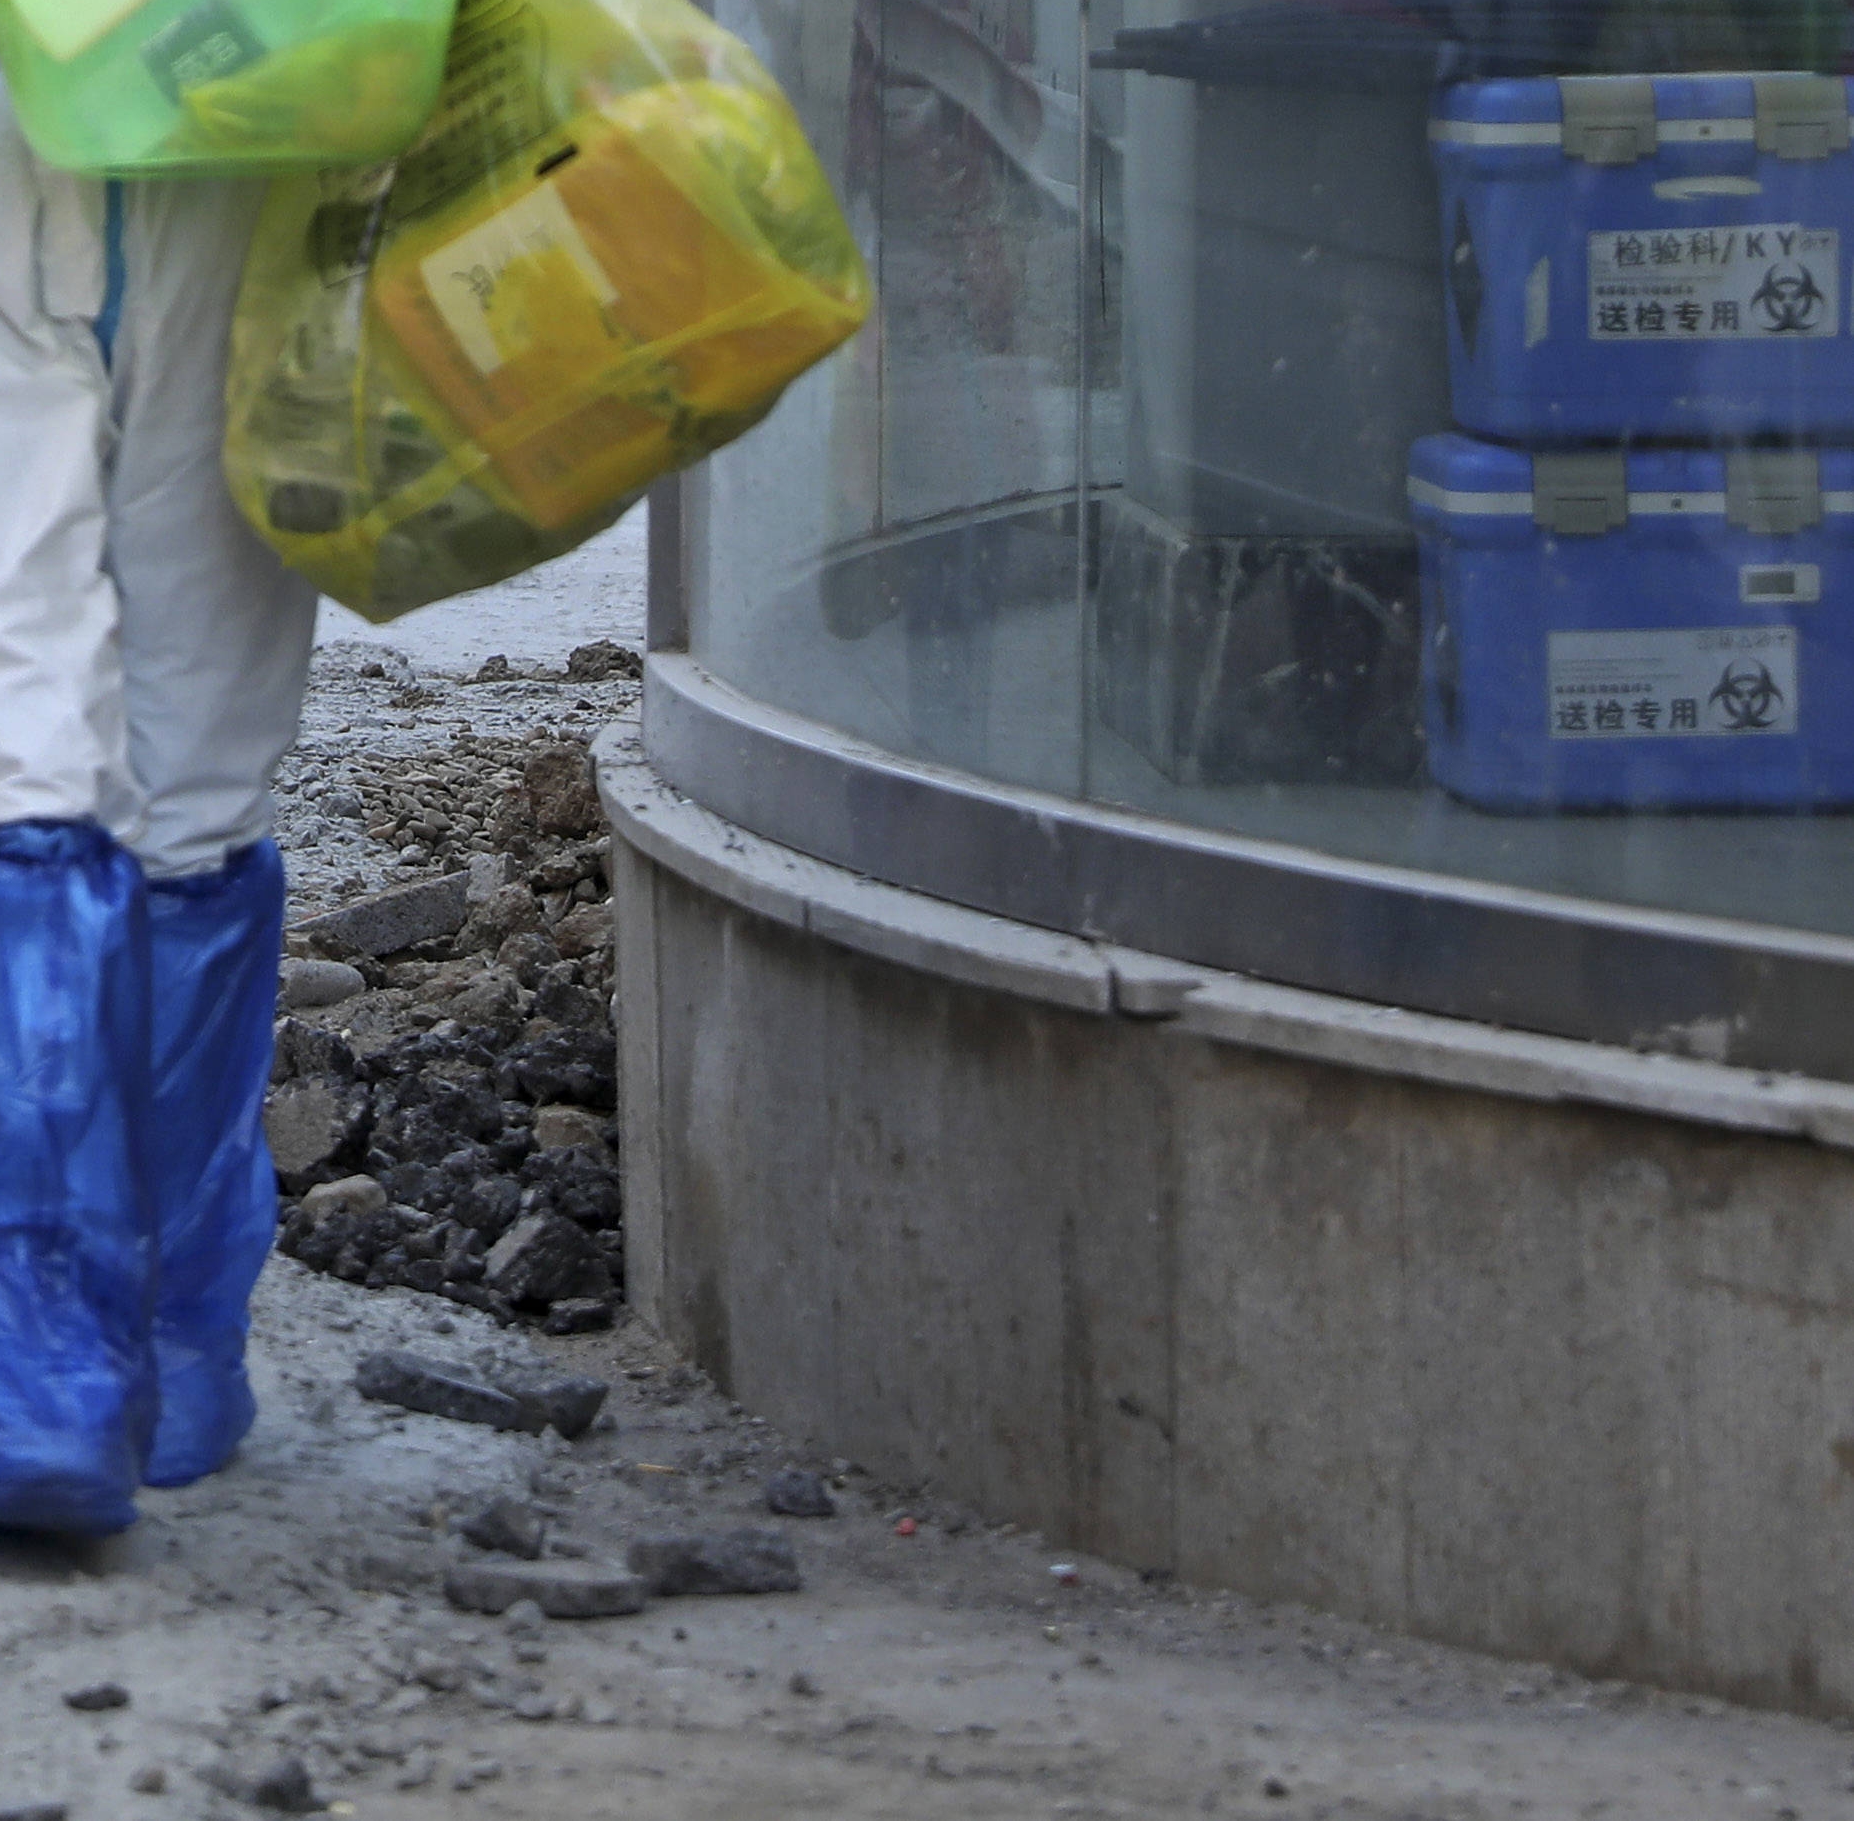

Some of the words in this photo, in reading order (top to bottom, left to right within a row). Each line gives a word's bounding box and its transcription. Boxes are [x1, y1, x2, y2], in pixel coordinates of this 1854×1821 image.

[1596, 300, 1740, 331] 送检专用
[1556, 697, 1699, 730] 送检专用
